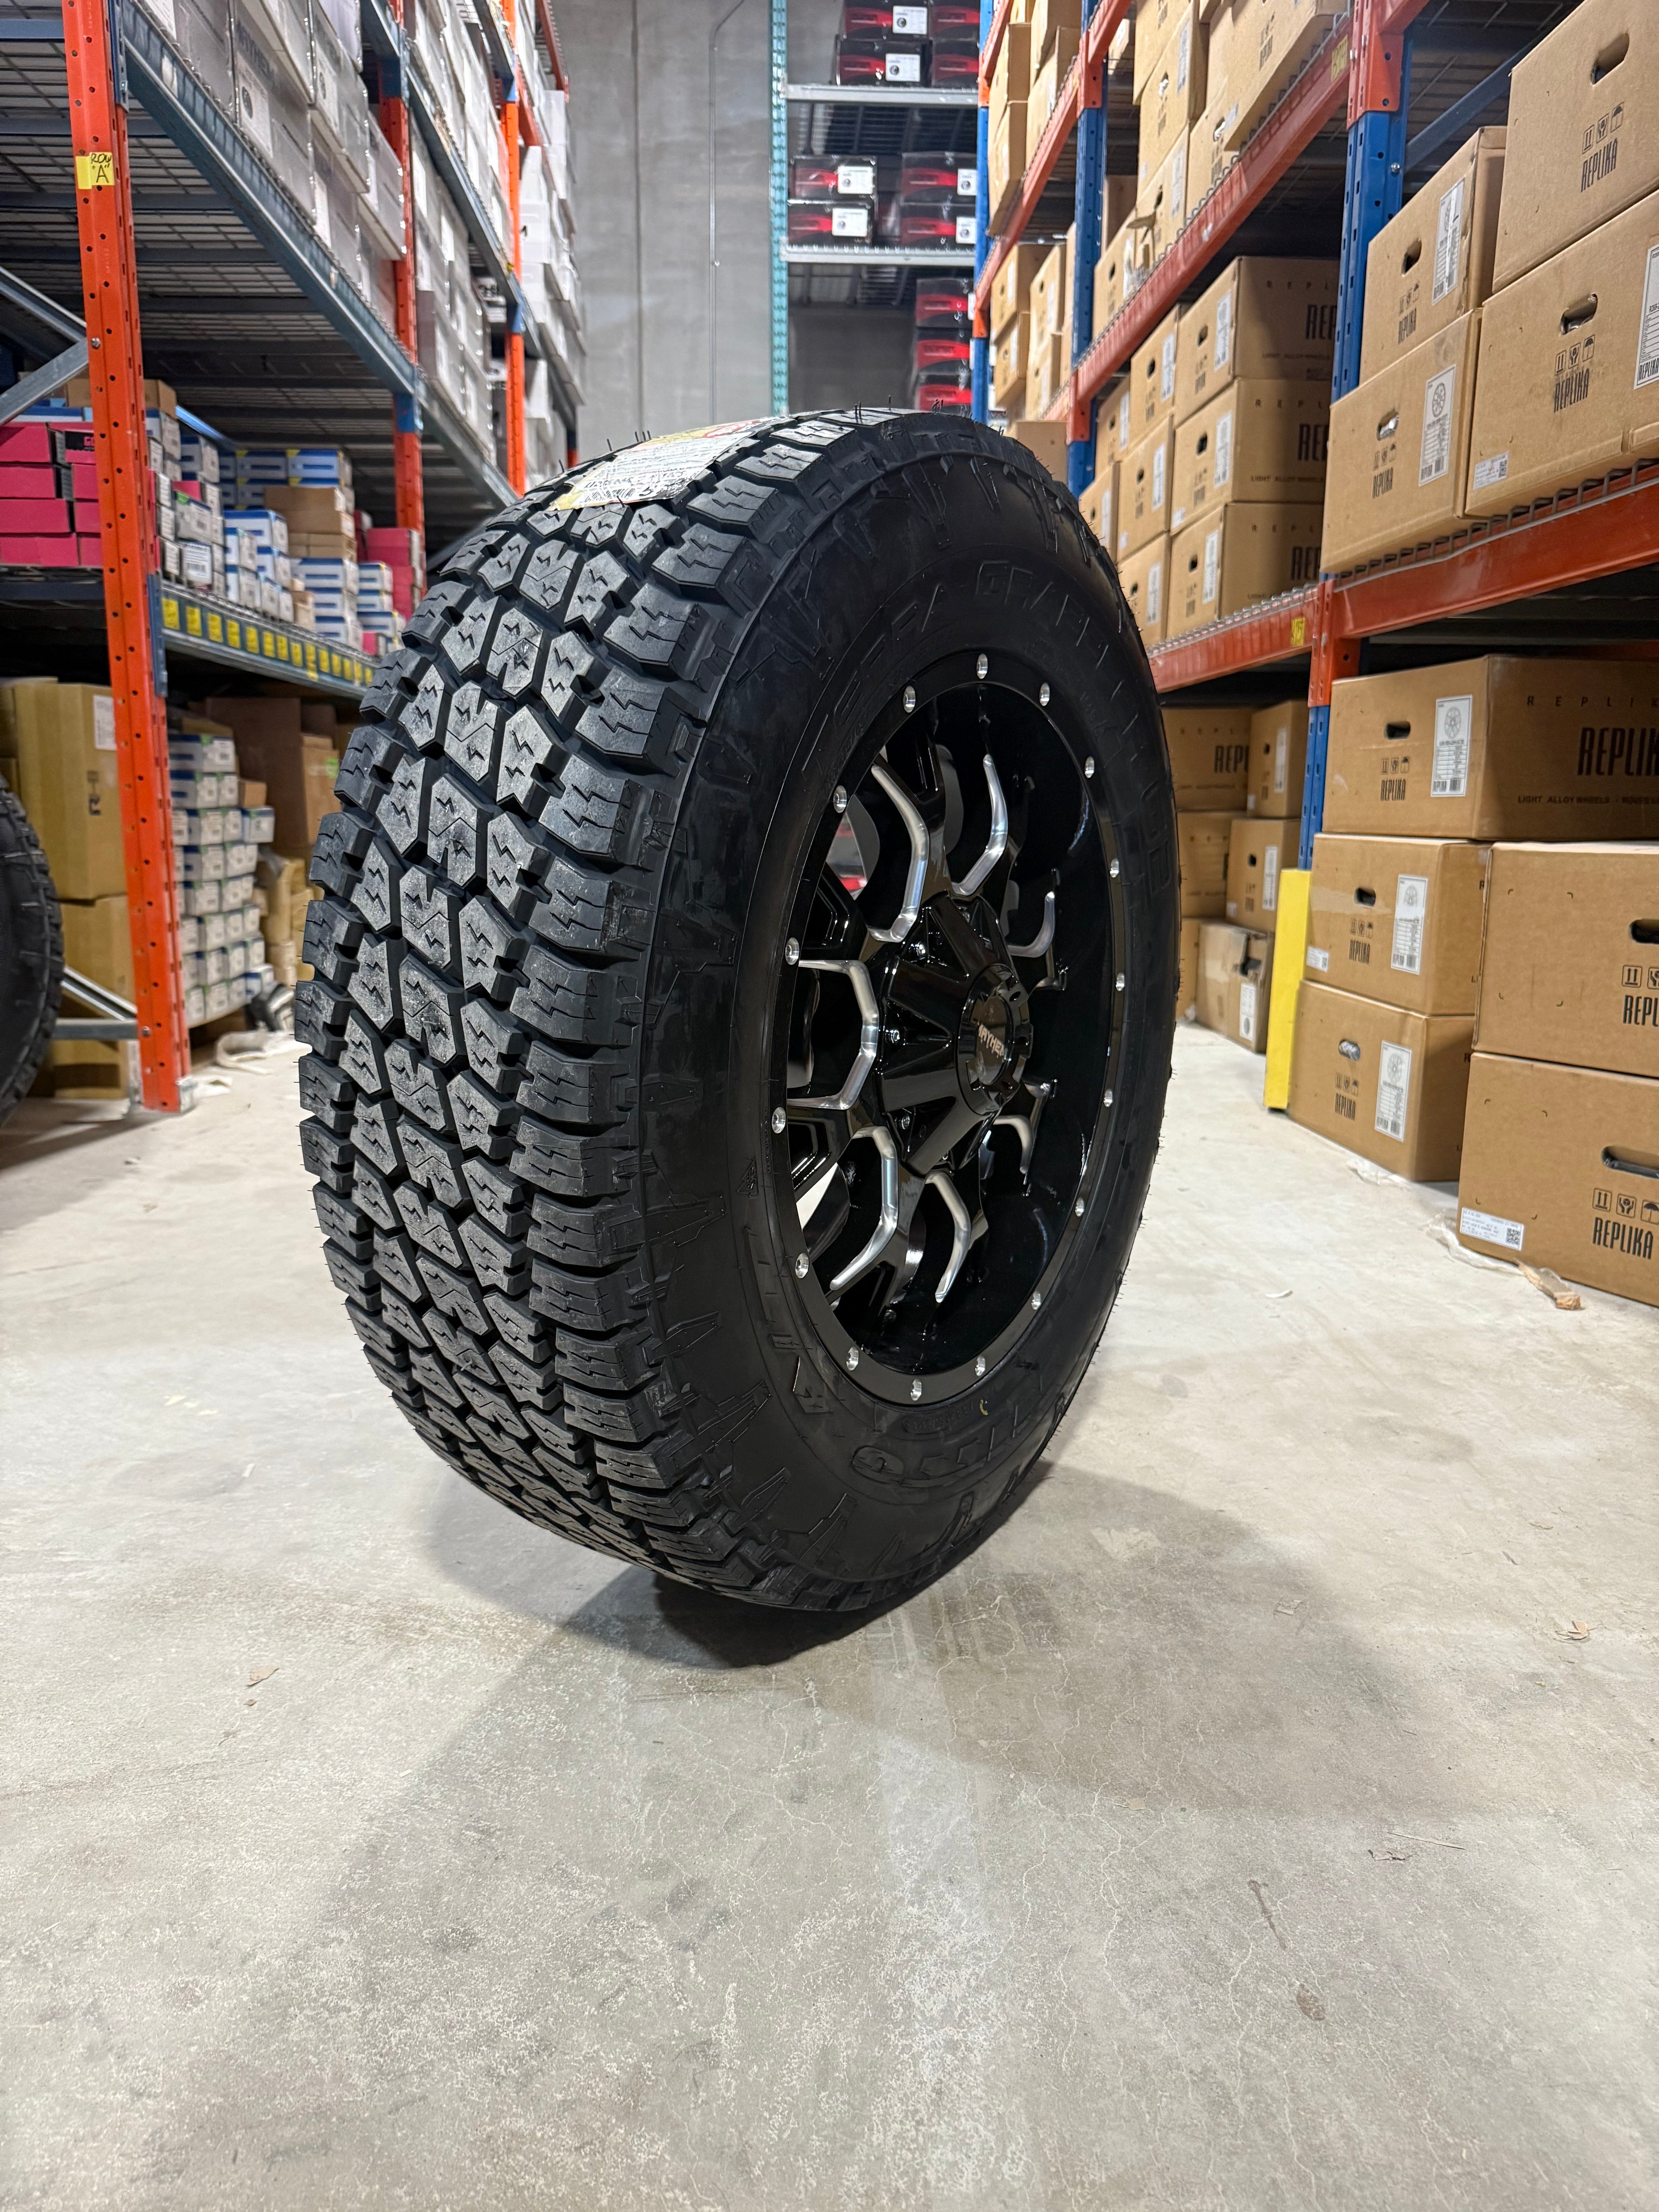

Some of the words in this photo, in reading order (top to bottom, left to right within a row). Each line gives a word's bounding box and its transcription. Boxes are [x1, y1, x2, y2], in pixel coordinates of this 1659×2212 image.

[91, 153, 112, 164] ROW
[1581, 137, 1618, 193] REPLIKA
[1554, 367, 1589, 413] REPLIKA
[1372, 466, 1393, 499] REPLIKA
[1380, 779, 1406, 801] REPLIKA
[1349, 939, 1370, 965] REPLIKA
[1623, 995, 1659, 1027] REPL
[1335, 1093, 1356, 1121] REPLIKA
[1591, 1217, 1653, 1261] REPLIKA
